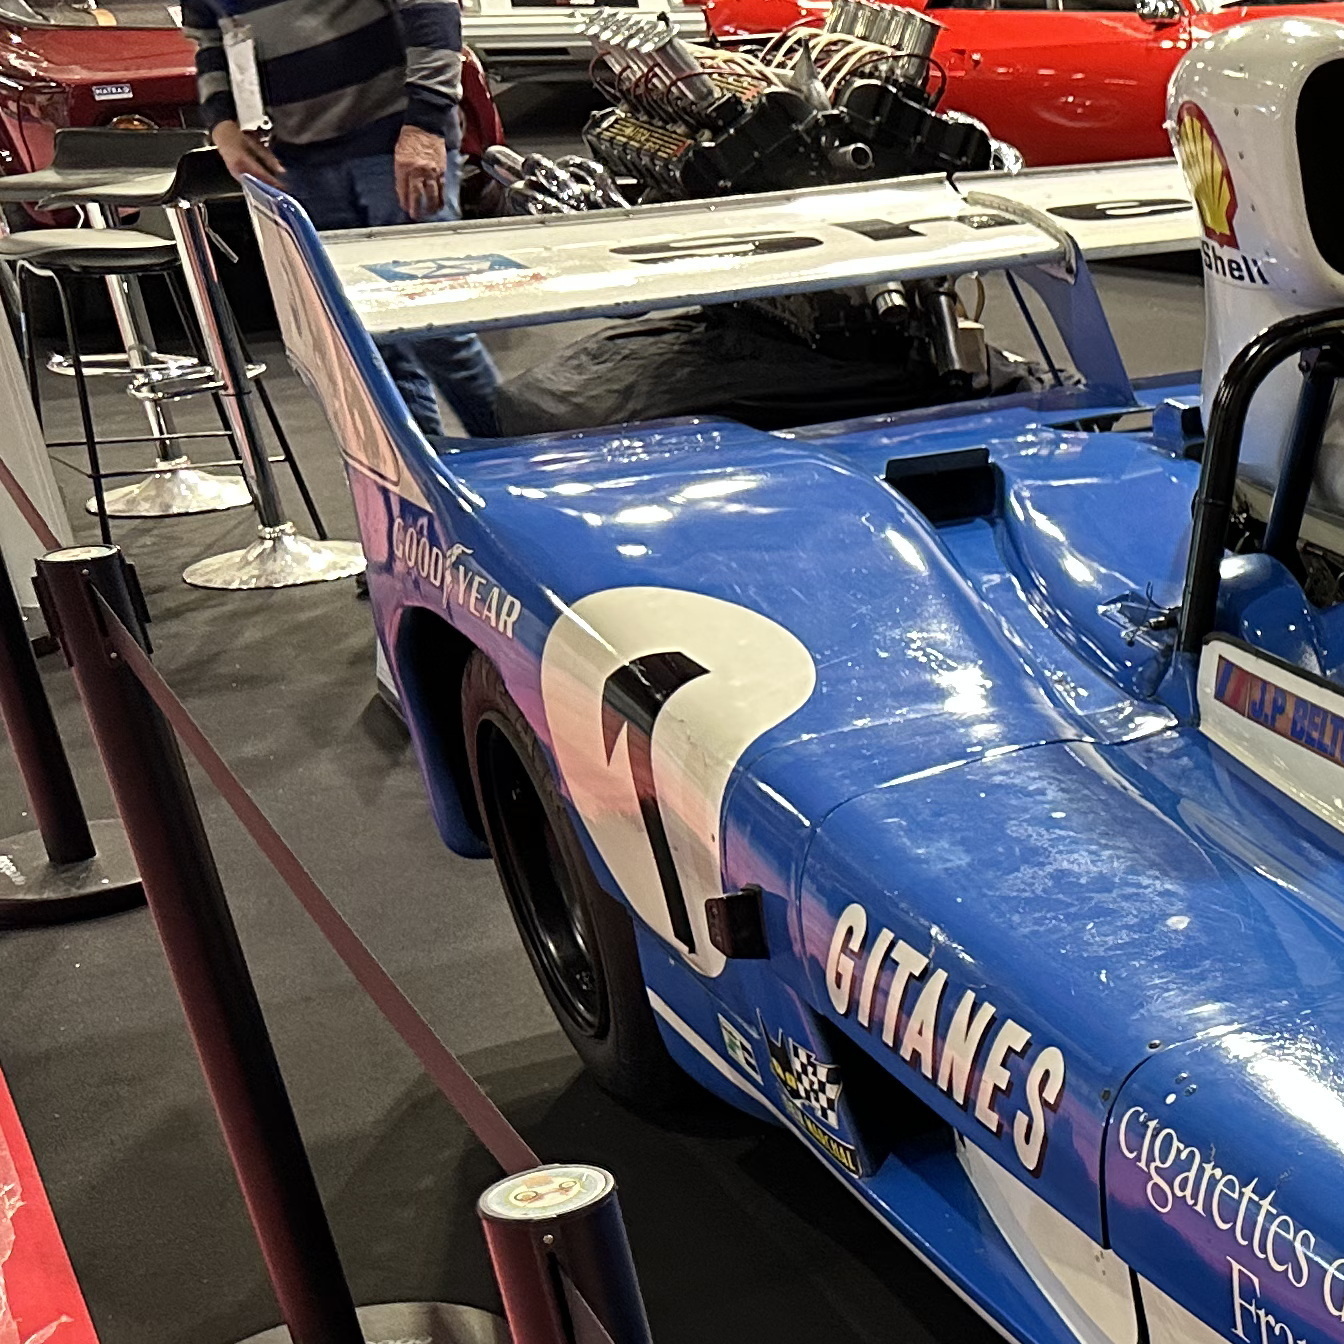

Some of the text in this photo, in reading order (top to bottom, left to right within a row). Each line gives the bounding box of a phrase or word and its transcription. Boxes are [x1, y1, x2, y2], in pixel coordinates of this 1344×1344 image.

[1201, 240, 1269, 285] Shell
[393, 517, 522, 639] GOODYEAR
[825, 903, 1069, 1177] GITANES
[1118, 1103, 1316, 1288] cigarettes
